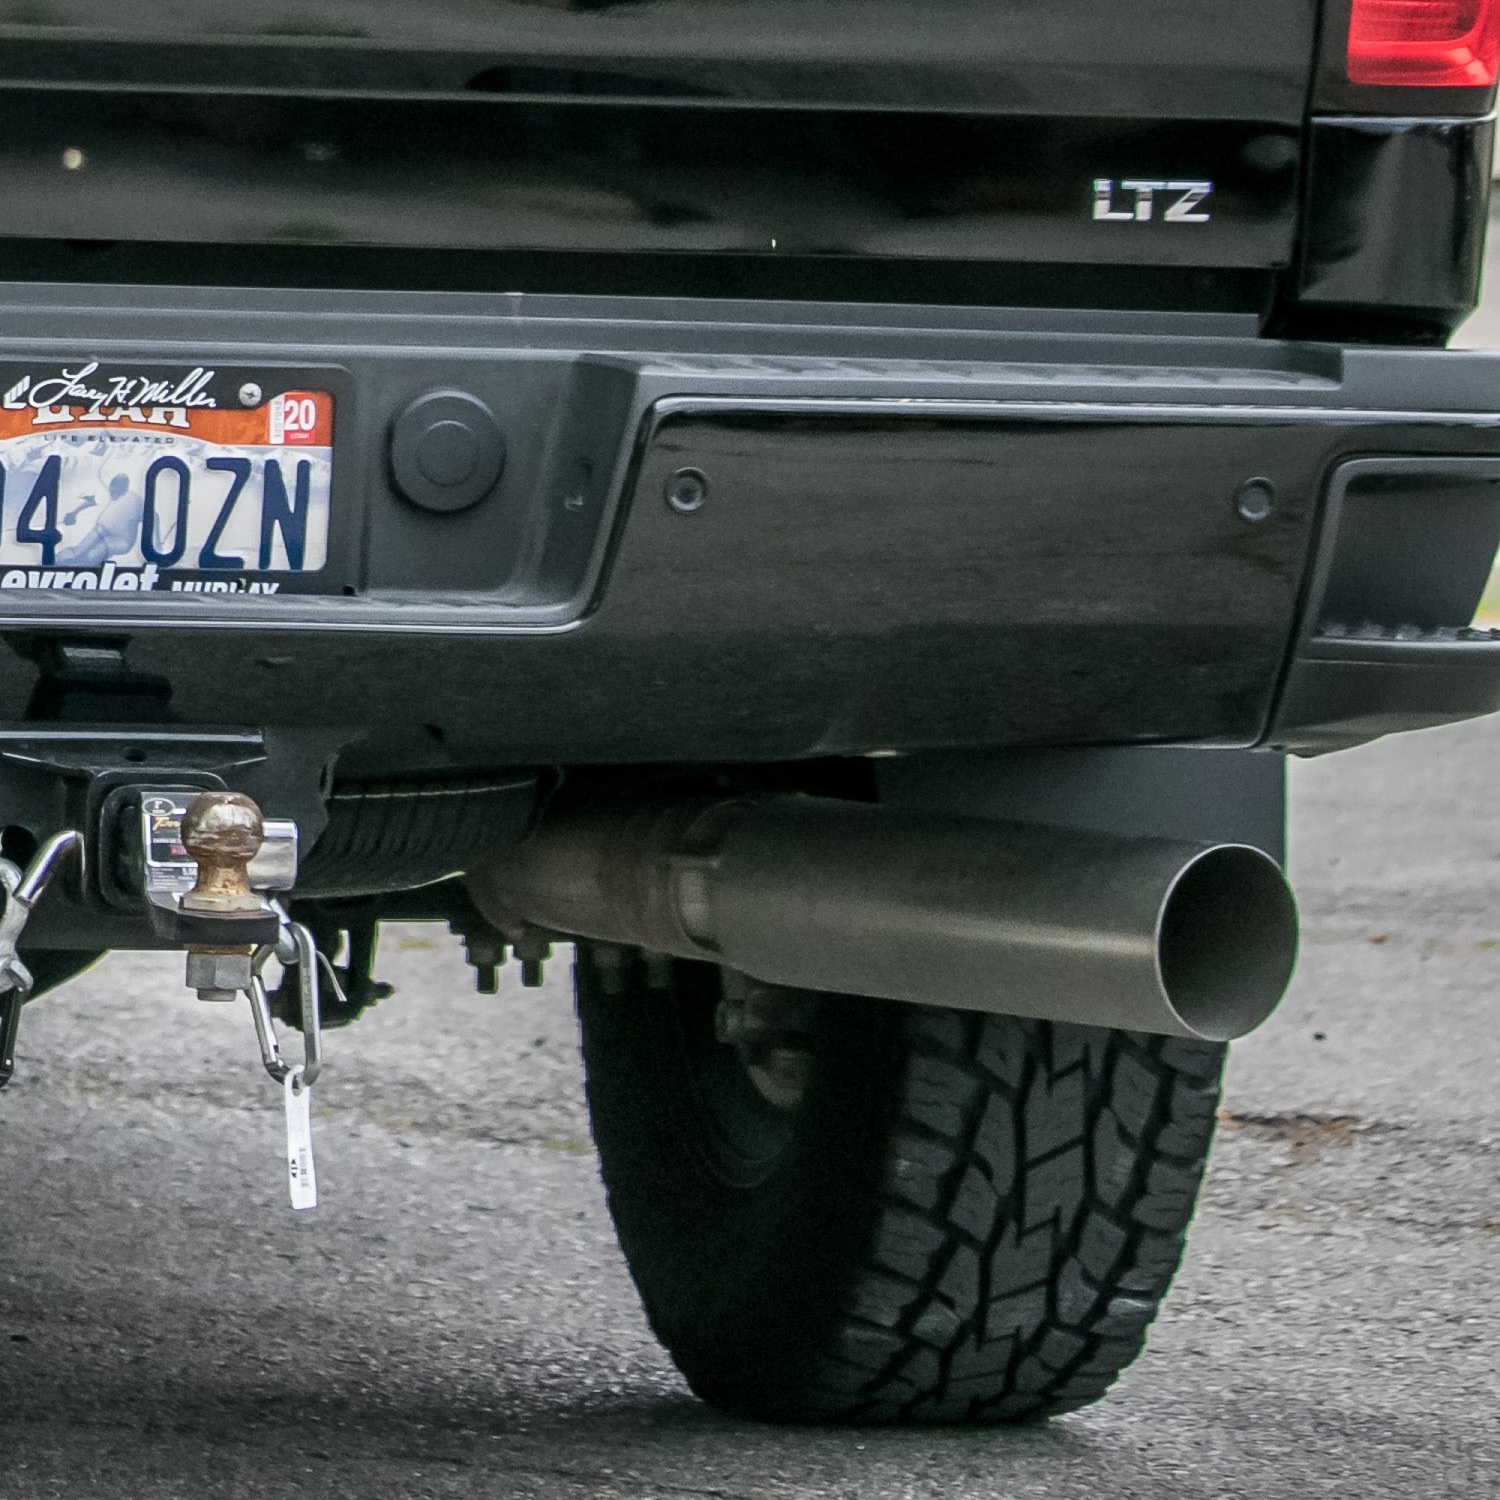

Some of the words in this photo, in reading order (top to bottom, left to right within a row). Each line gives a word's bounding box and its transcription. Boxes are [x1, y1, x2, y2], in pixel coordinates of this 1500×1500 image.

[1093, 178, 1213, 222] LTZ
[129, 366, 217, 408] Miller
[284, 399, 316, 431] 20
[43, 433, 78, 443] LIFE
[87, 434, 175, 445] ELEVATED
[140, 455, 311, 572] 0ZN
